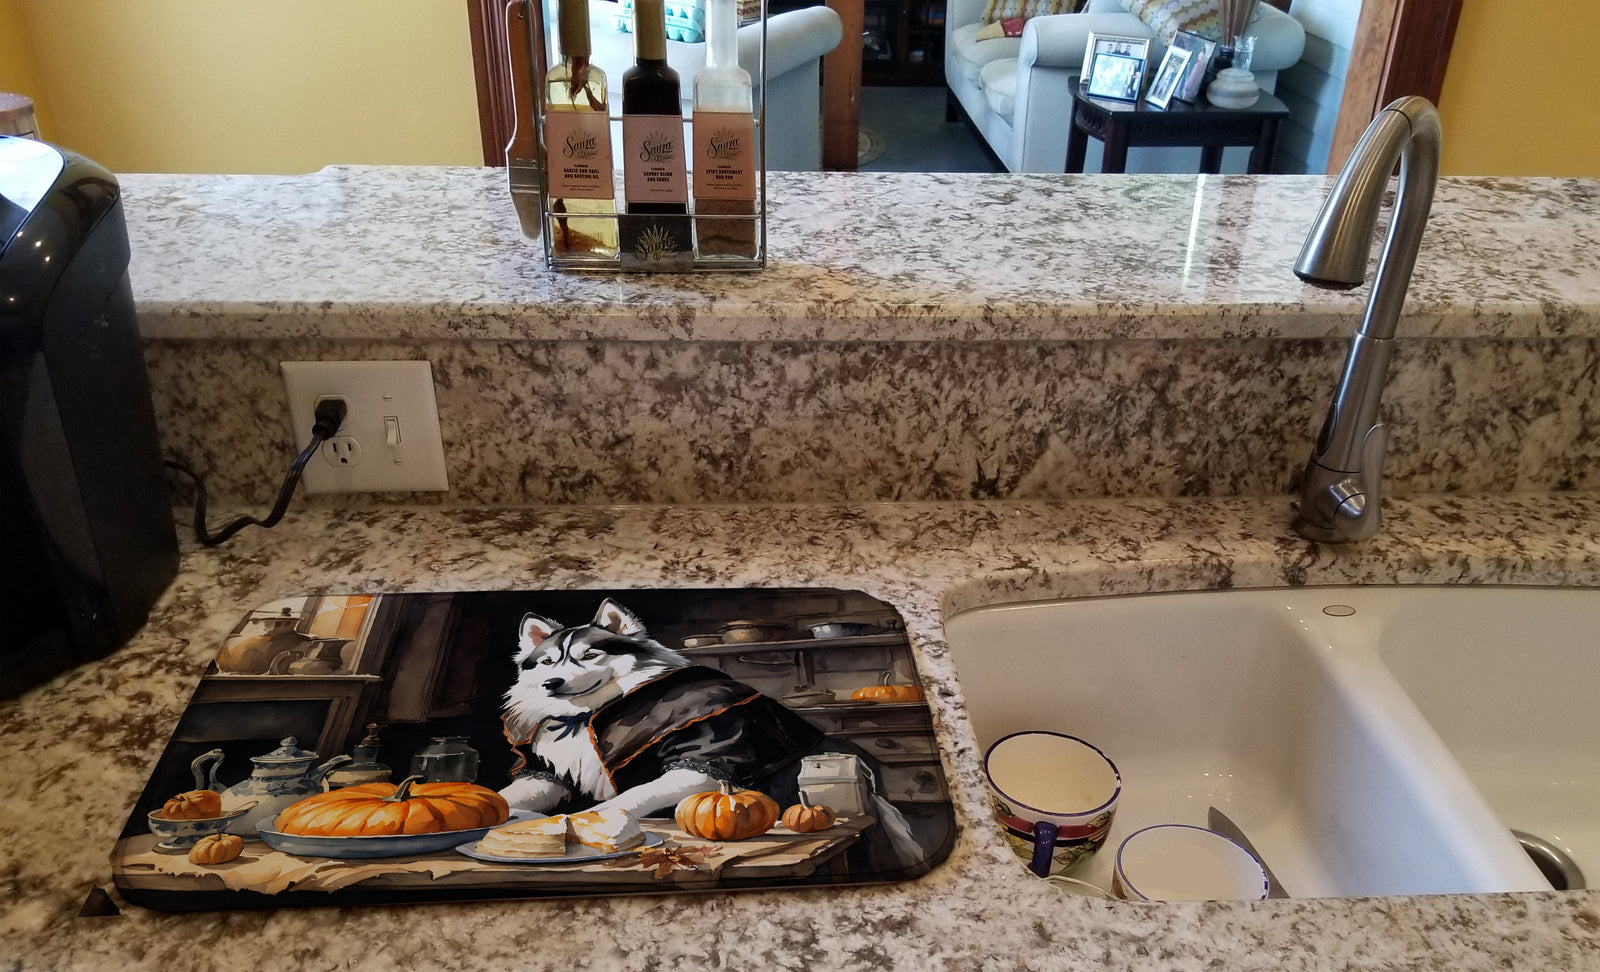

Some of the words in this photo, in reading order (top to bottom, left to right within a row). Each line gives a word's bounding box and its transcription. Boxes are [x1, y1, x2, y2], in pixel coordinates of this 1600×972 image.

[563, 136, 597, 158] Sauza
[640, 140, 674, 161] Sauza
[707, 136, 739, 159] Sauza
